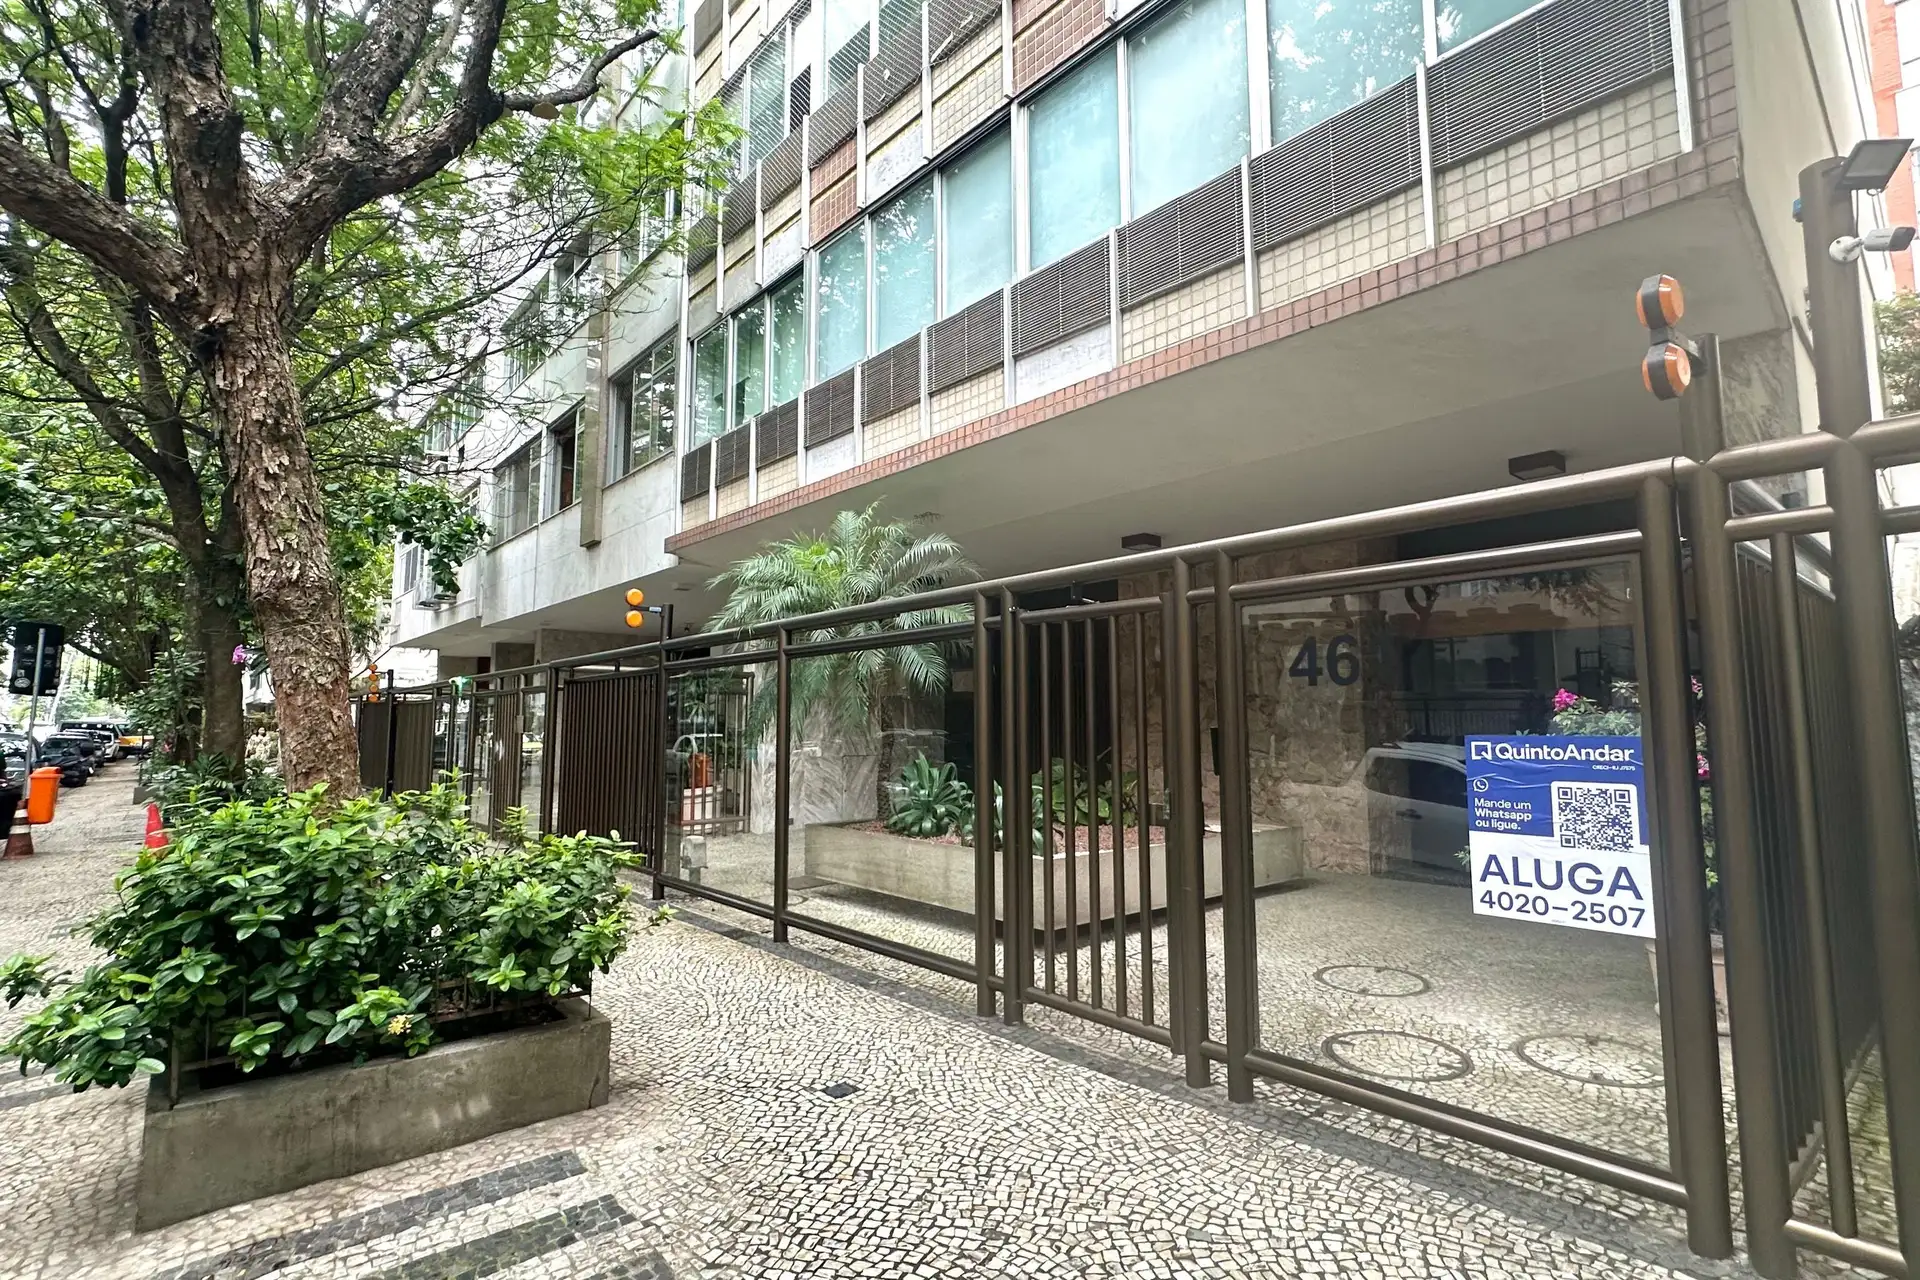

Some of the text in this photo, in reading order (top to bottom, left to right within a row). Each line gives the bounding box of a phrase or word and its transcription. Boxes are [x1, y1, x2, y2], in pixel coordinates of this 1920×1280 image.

[1289, 634, 1361, 686] 46
[1495, 742, 1635, 762] QuintoAndar
[1474, 797, 1532, 811] Mande um
[1474, 808, 1532, 822] Whatsapp
[1475, 819, 1521, 831] ou ligue.
[1479, 854, 1644, 901] ALUGA
[1480, 889, 1646, 928] 4020-2507
